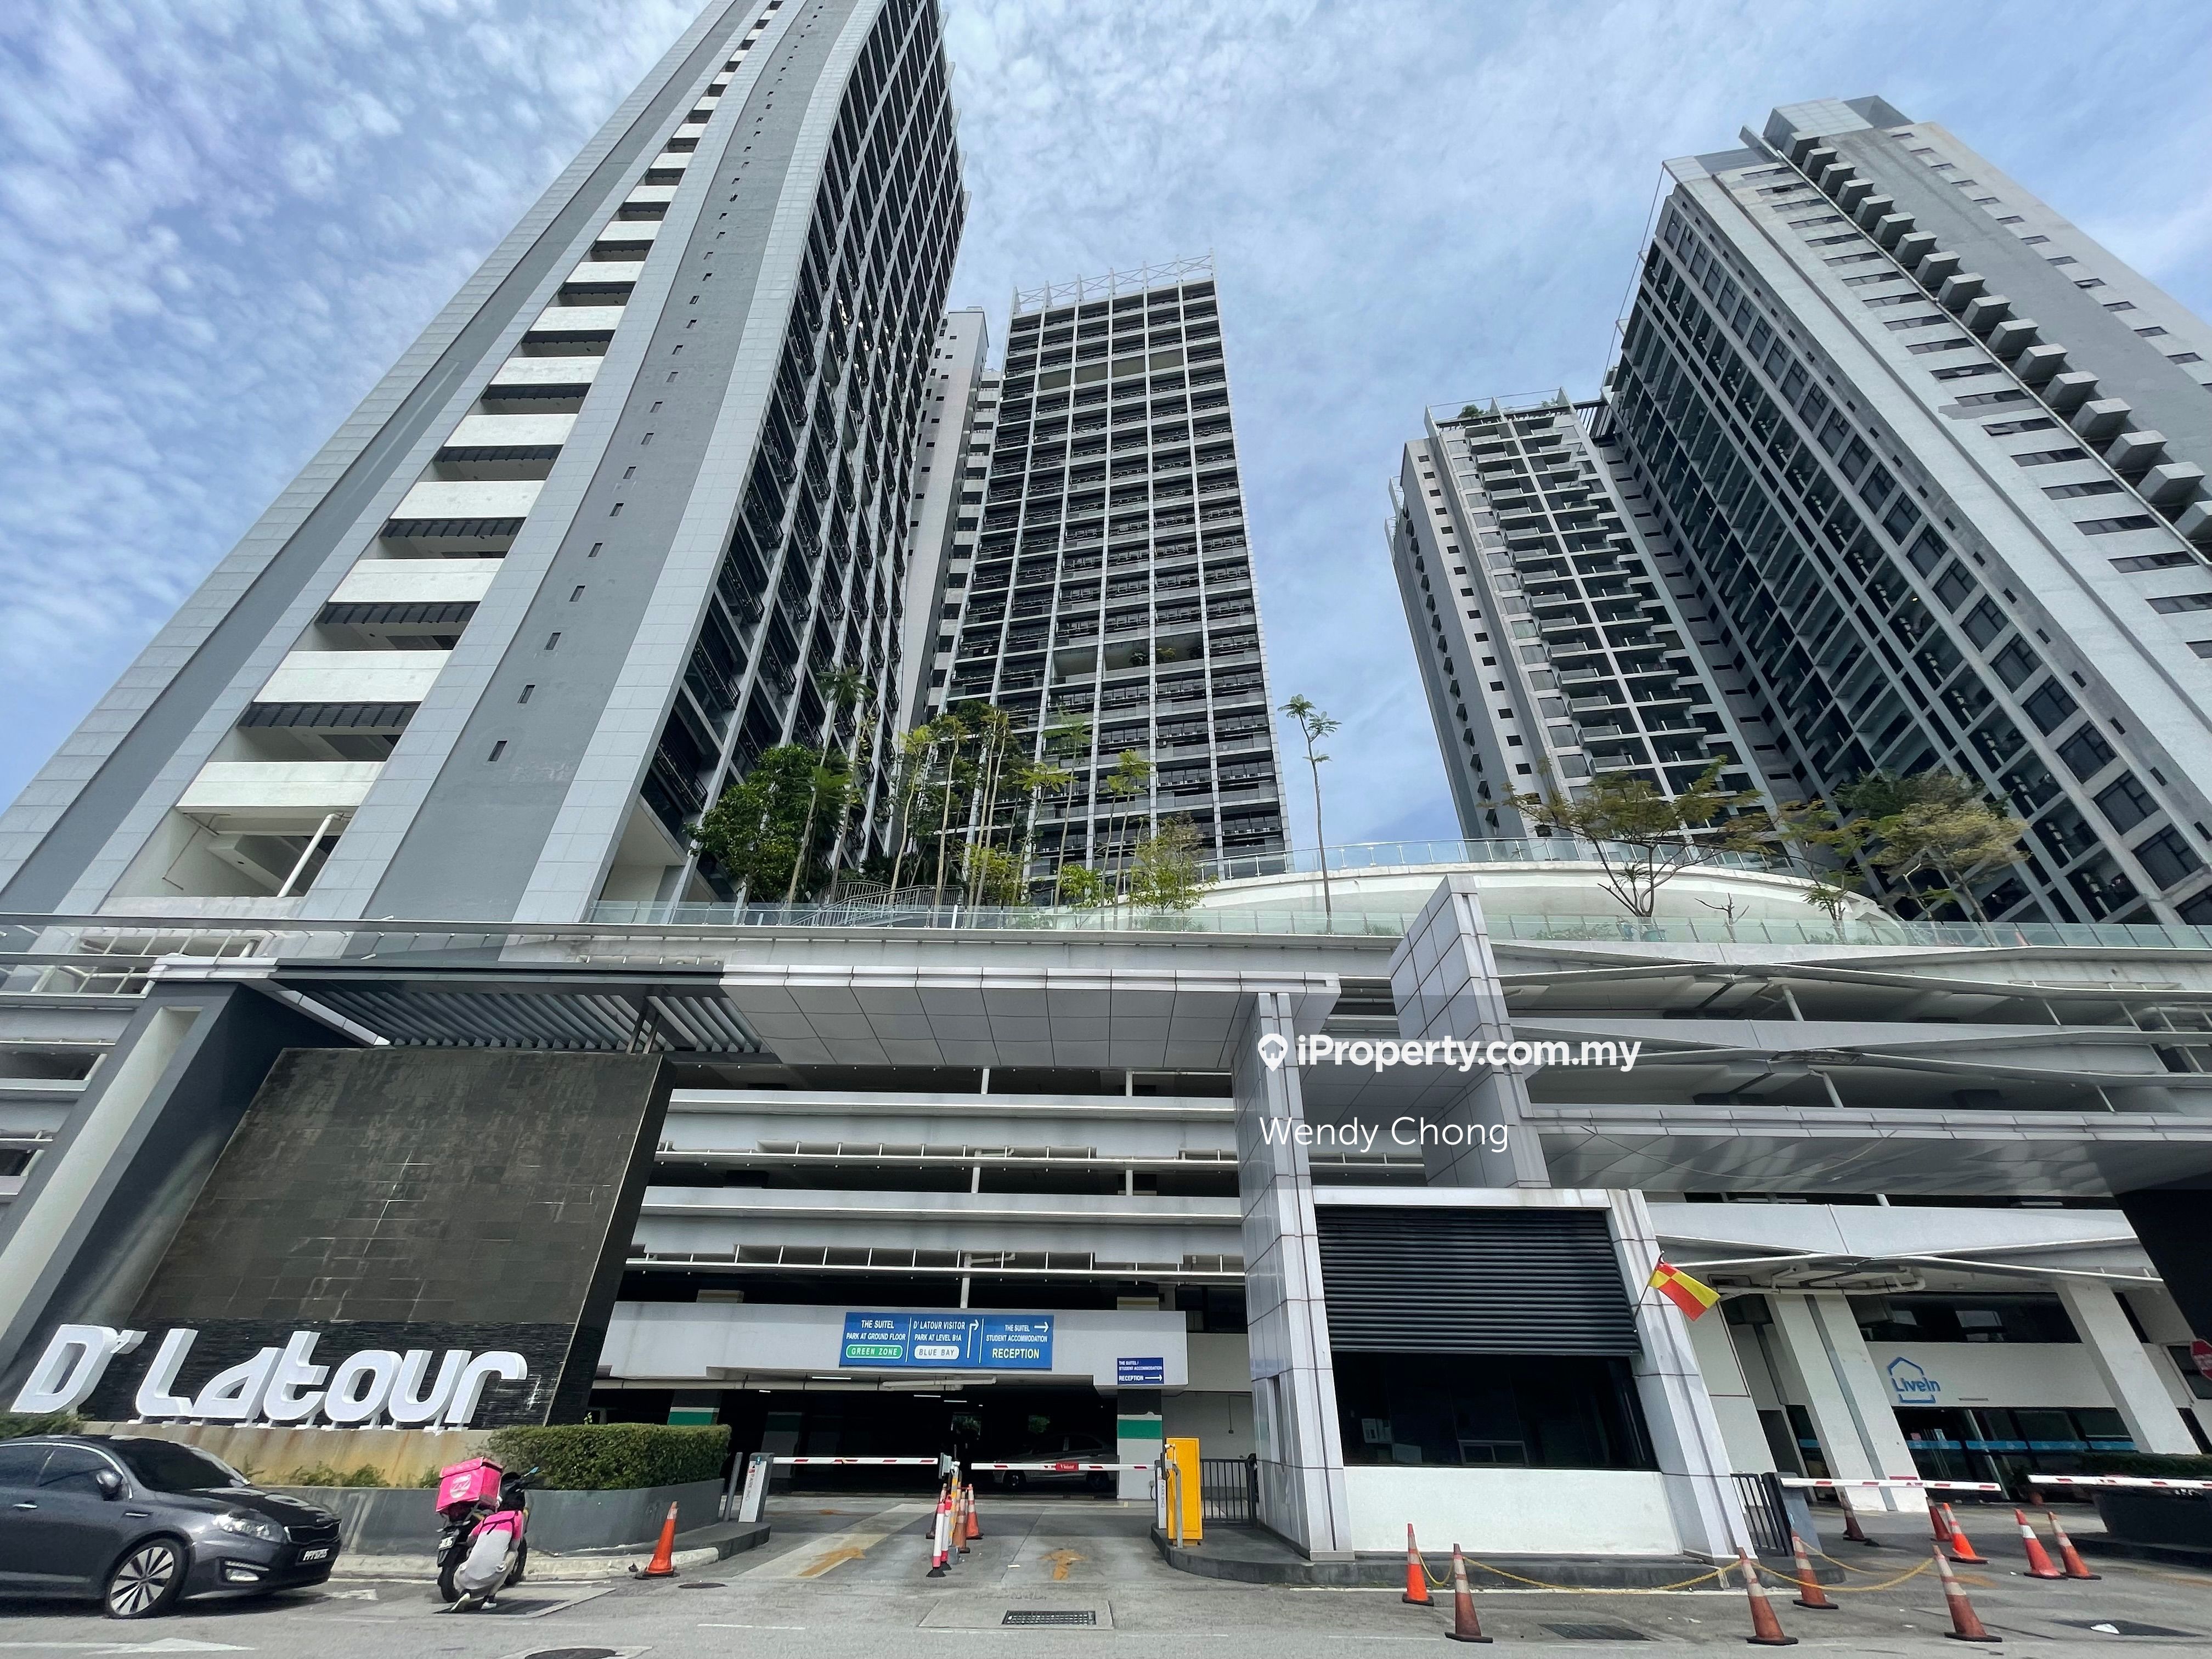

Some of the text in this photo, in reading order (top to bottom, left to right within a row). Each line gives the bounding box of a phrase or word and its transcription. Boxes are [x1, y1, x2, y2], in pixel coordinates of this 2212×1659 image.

[861, 1320, 894, 1329] THE SUITEL
[920, 1321, 943, 1329] LATOUR
[943, 1321, 966, 1330] VISITOR
[992, 1348, 1040, 1359] RECEPTION
[9, 1324, 528, 1425] D' Latour
